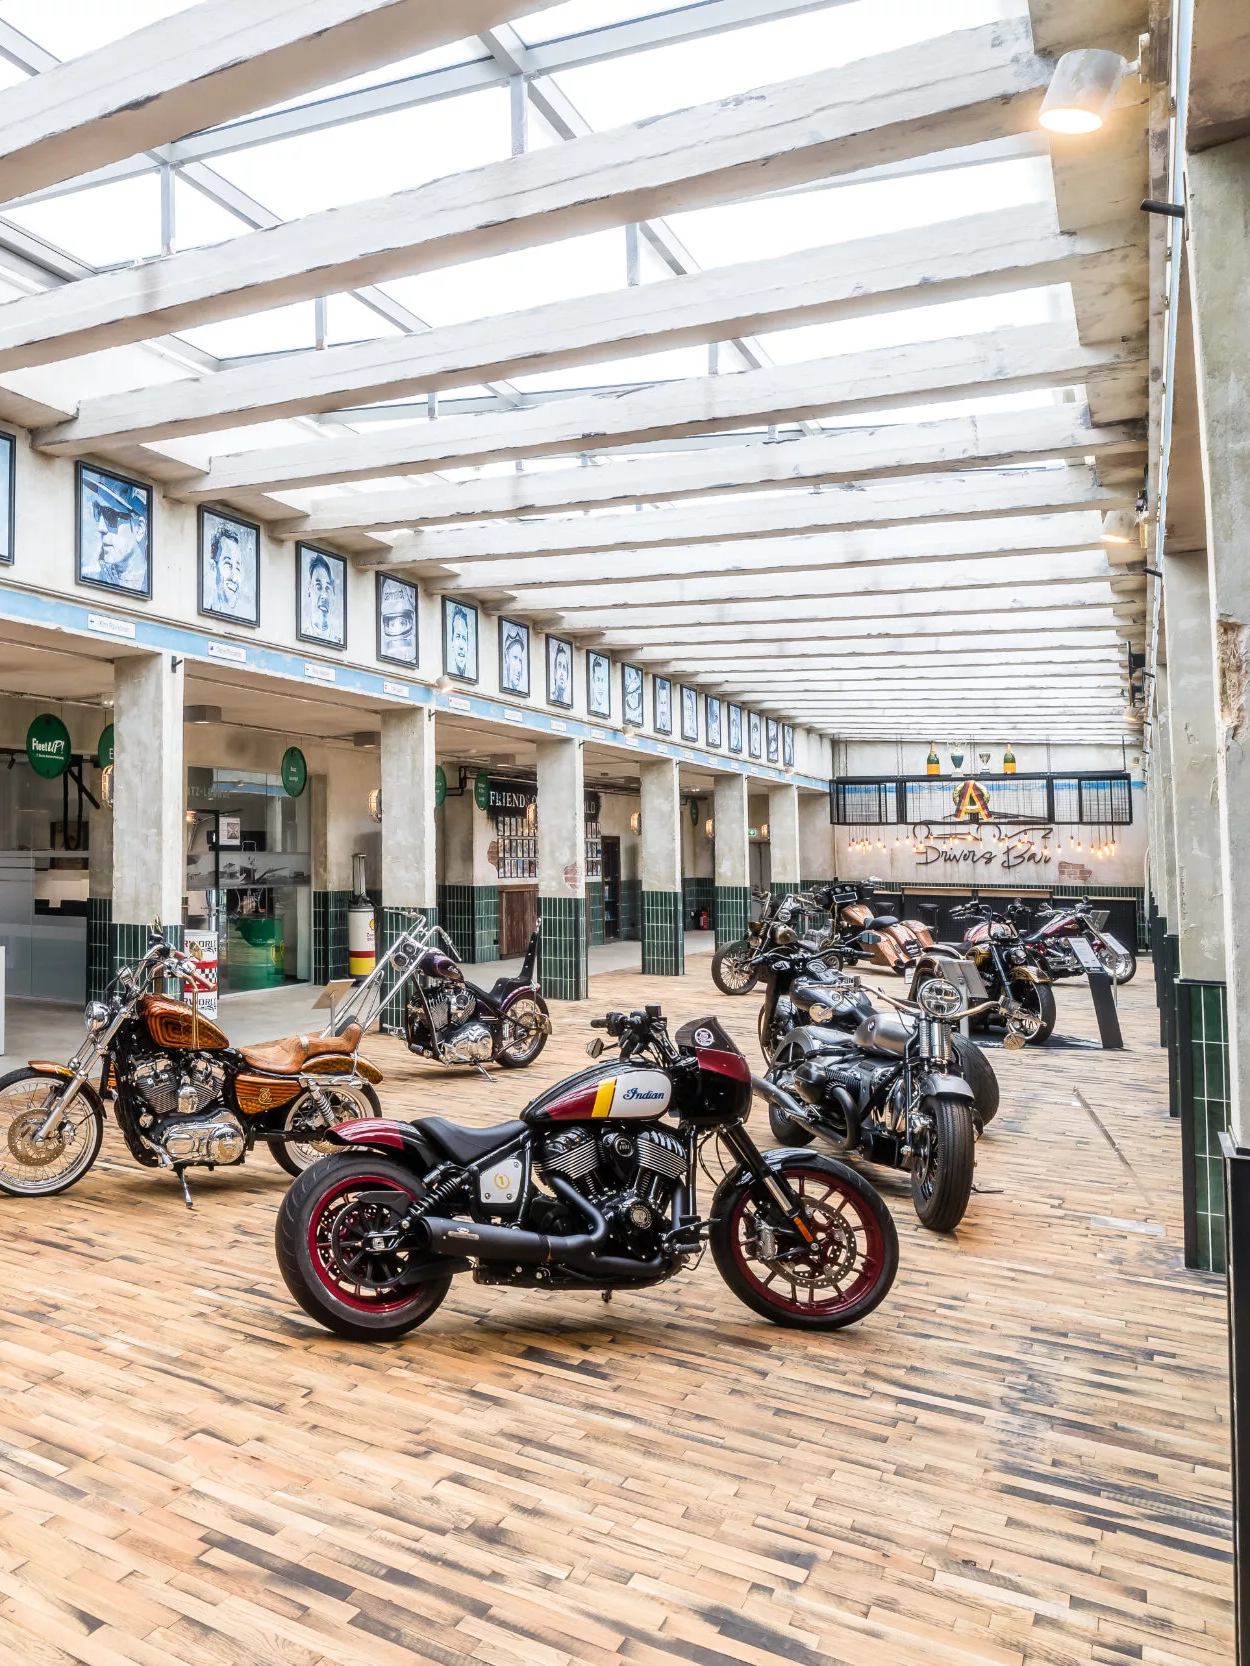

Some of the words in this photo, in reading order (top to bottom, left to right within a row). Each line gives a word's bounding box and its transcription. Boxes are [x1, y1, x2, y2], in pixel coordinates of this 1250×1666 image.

[490, 791, 530, 808] FRIENDS
[913, 845, 997, 865] Drivers
[1001, 841, 1052, 870] Bar
[622, 1087, 665, 1100] Indian
